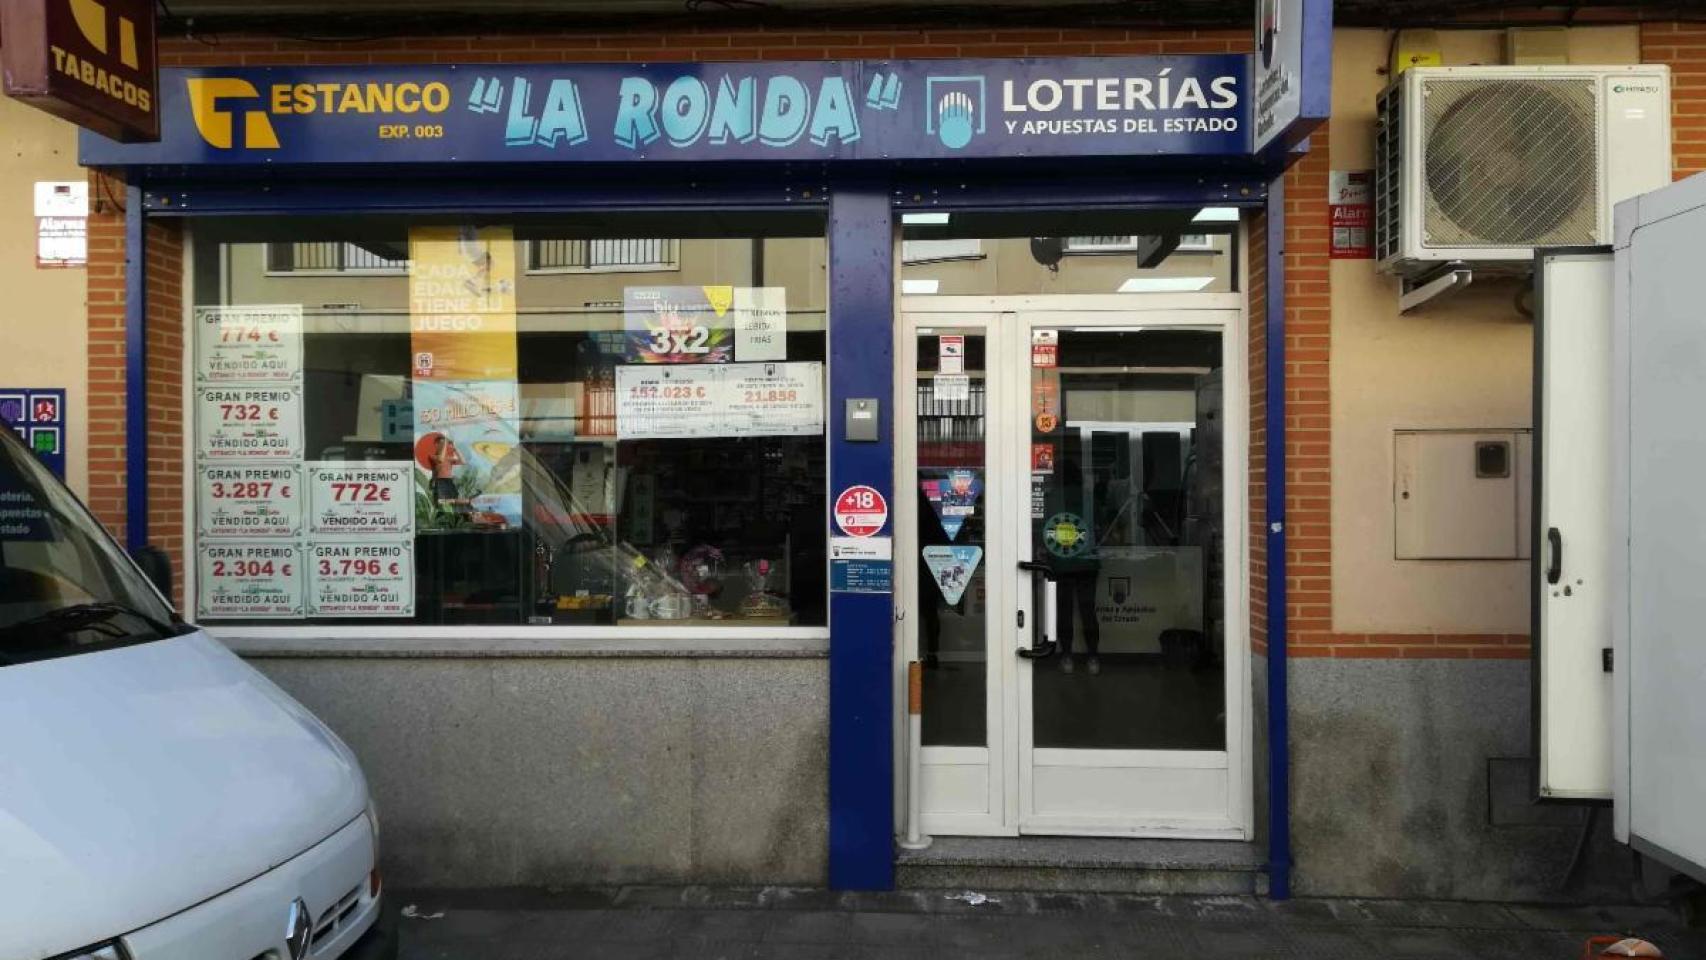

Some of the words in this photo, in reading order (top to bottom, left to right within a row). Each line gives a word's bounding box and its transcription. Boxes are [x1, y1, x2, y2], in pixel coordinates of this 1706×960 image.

[50, 45, 150, 112] TABACOS
[1002, 67, 1239, 112] LOTERÍAS
[271, 82, 450, 114] ESTANCO
[379, 125, 410, 139] EXP.
[415, 125, 444, 138] 003
[1005, 120, 1016, 134] Y
[1022, 119, 1116, 134] APUESTAS
[1124, 118, 1158, 133] DEL
[1163, 117, 1239, 132] ESTADO
[414, 298, 470, 313] TIENE
[416, 315, 482, 331] JUEGO
[650, 327, 709, 354] 3x2
[209, 361, 258, 369] VENDIDO
[206, 392, 240, 401] GRAN
[246, 392, 291, 401] PREMIO
[220, 404, 261, 420] 732
[268, 407, 279, 420] €
[209, 439, 258, 448] VENDIDO
[208, 470, 241, 479] GRAN
[246, 470, 291, 479] PREMIO
[319, 473, 353, 481] GRAN
[357, 473, 399, 481] PREMIO
[212, 482, 273, 498] 3.287
[281, 485, 291, 498] €
[331, 483, 391, 501] 772€
[845, 491, 874, 509] +18
[211, 517, 260, 526] VENDIDO
[322, 517, 367, 526] VENDIDO
[209, 548, 242, 558] GRAN
[247, 548, 292, 558] PREMIO
[316, 547, 349, 556] GRAN
[355, 547, 400, 556] PREMIO
[213, 560, 275, 576] 2.304
[282, 564, 292, 577] €
[319, 559, 381, 575] 3.796
[389, 562, 399, 575] €
[212, 595, 260, 604] VENDIDO
[320, 594, 368, 602] VENDIDO
